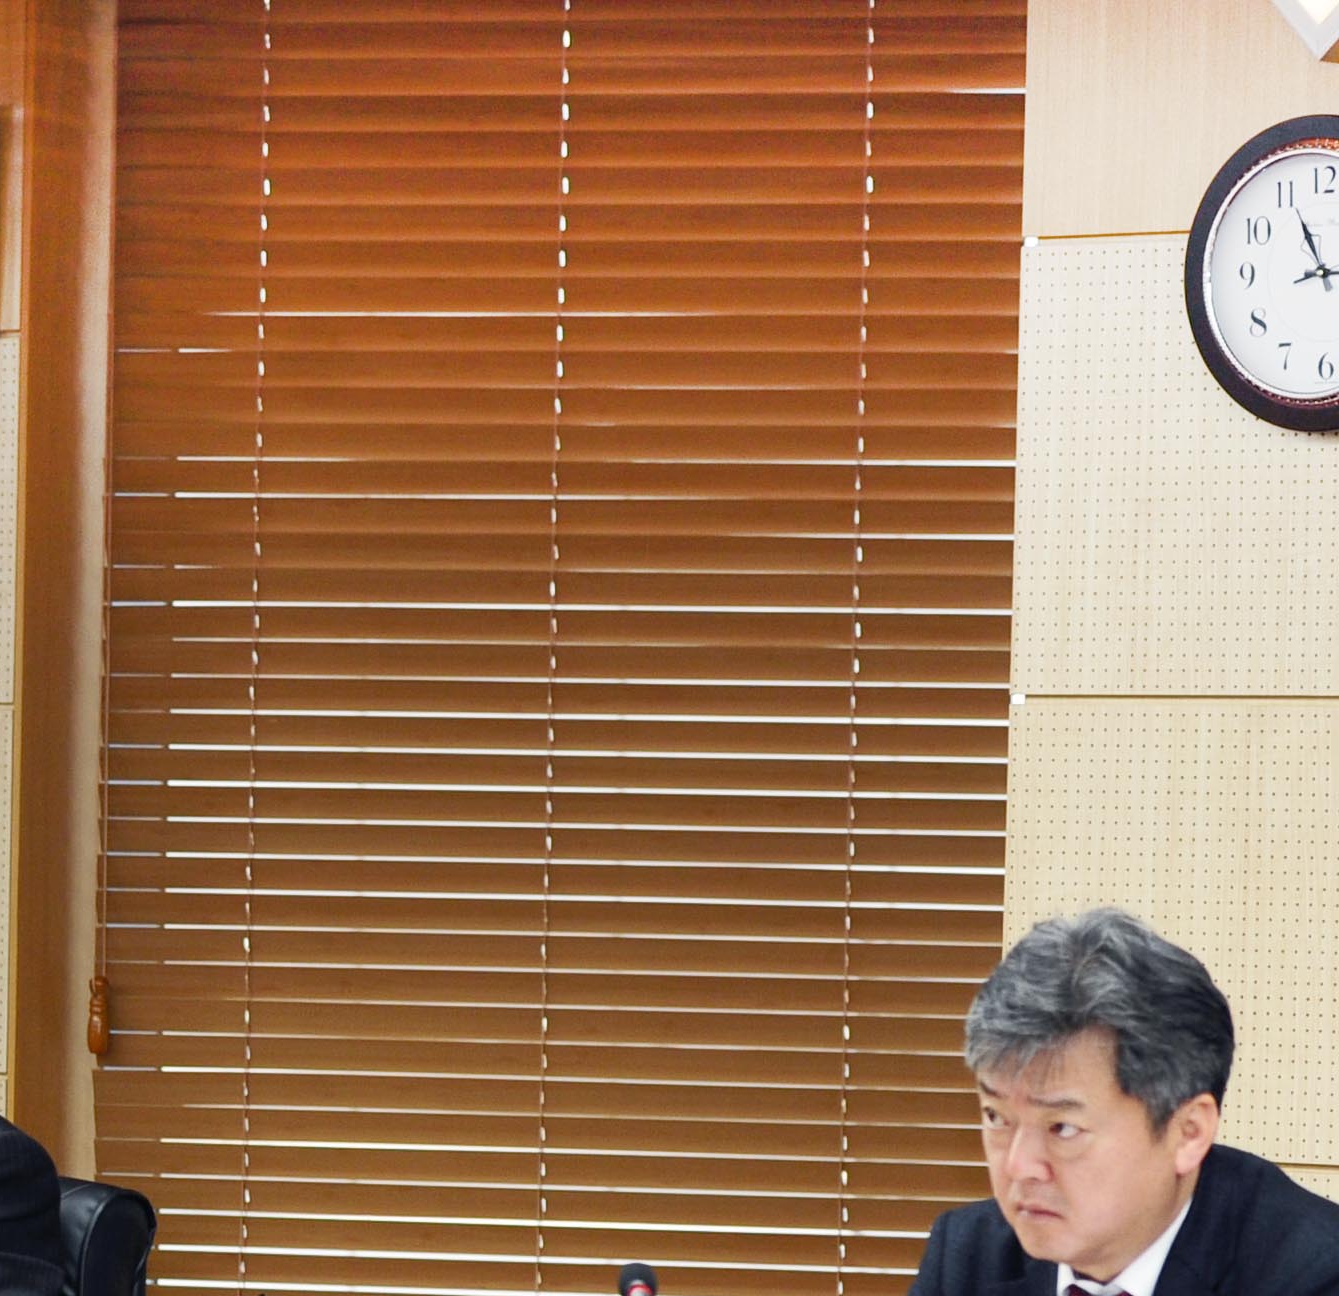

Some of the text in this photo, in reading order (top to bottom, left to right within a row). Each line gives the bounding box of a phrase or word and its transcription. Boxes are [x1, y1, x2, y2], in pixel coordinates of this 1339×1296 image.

[1313, 165, 1337, 194] 12
[1277, 180, 1294, 208] 11
[1246, 216, 1271, 245] 10
[1240, 262, 1255, 290] 9
[1249, 308, 1267, 337] 8
[1278, 342, 1292, 370] 7
[1318, 352, 1334, 380] 6
